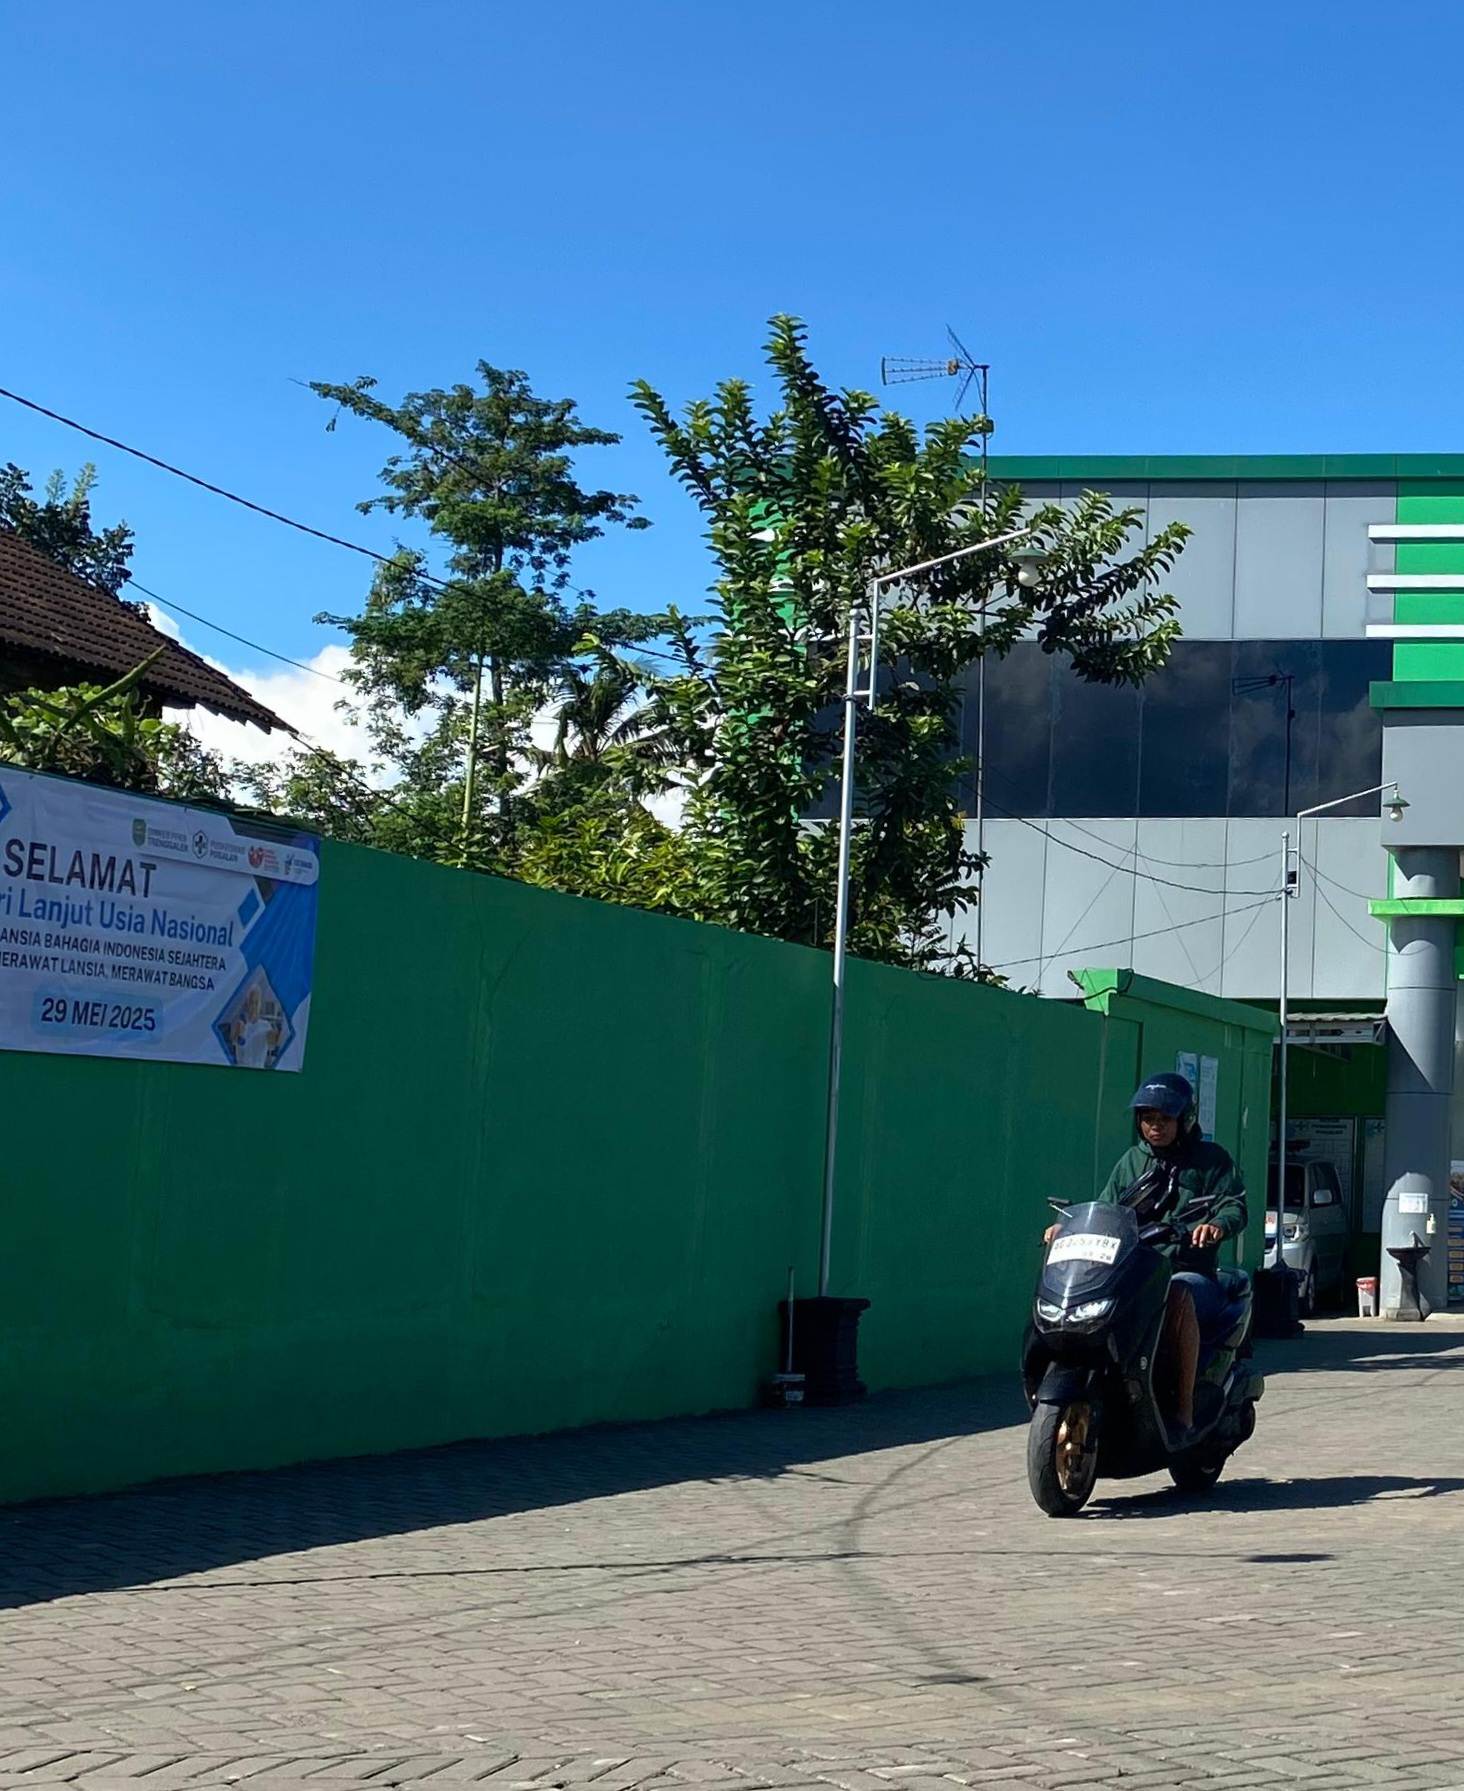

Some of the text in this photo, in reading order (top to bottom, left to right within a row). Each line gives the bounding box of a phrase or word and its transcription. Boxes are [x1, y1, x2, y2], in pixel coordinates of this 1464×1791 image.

[3, 838, 157, 898] SELAMAT
[18, 888, 93, 929] Lanjut
[101, 900, 145, 934] Usia
[151, 908, 234, 948] Nasional
[0, 951, 59, 973] ERAWAT
[111, 964, 168, 985] MERAWAT
[168, 972, 215, 991] BANGSA
[44, 933, 101, 954] BAHAGIA
[103, 941, 166, 964] INDONESIA
[167, 949, 227, 971] SEJAHTERA
[41, 997, 156, 1032] 29 MEI 2025
